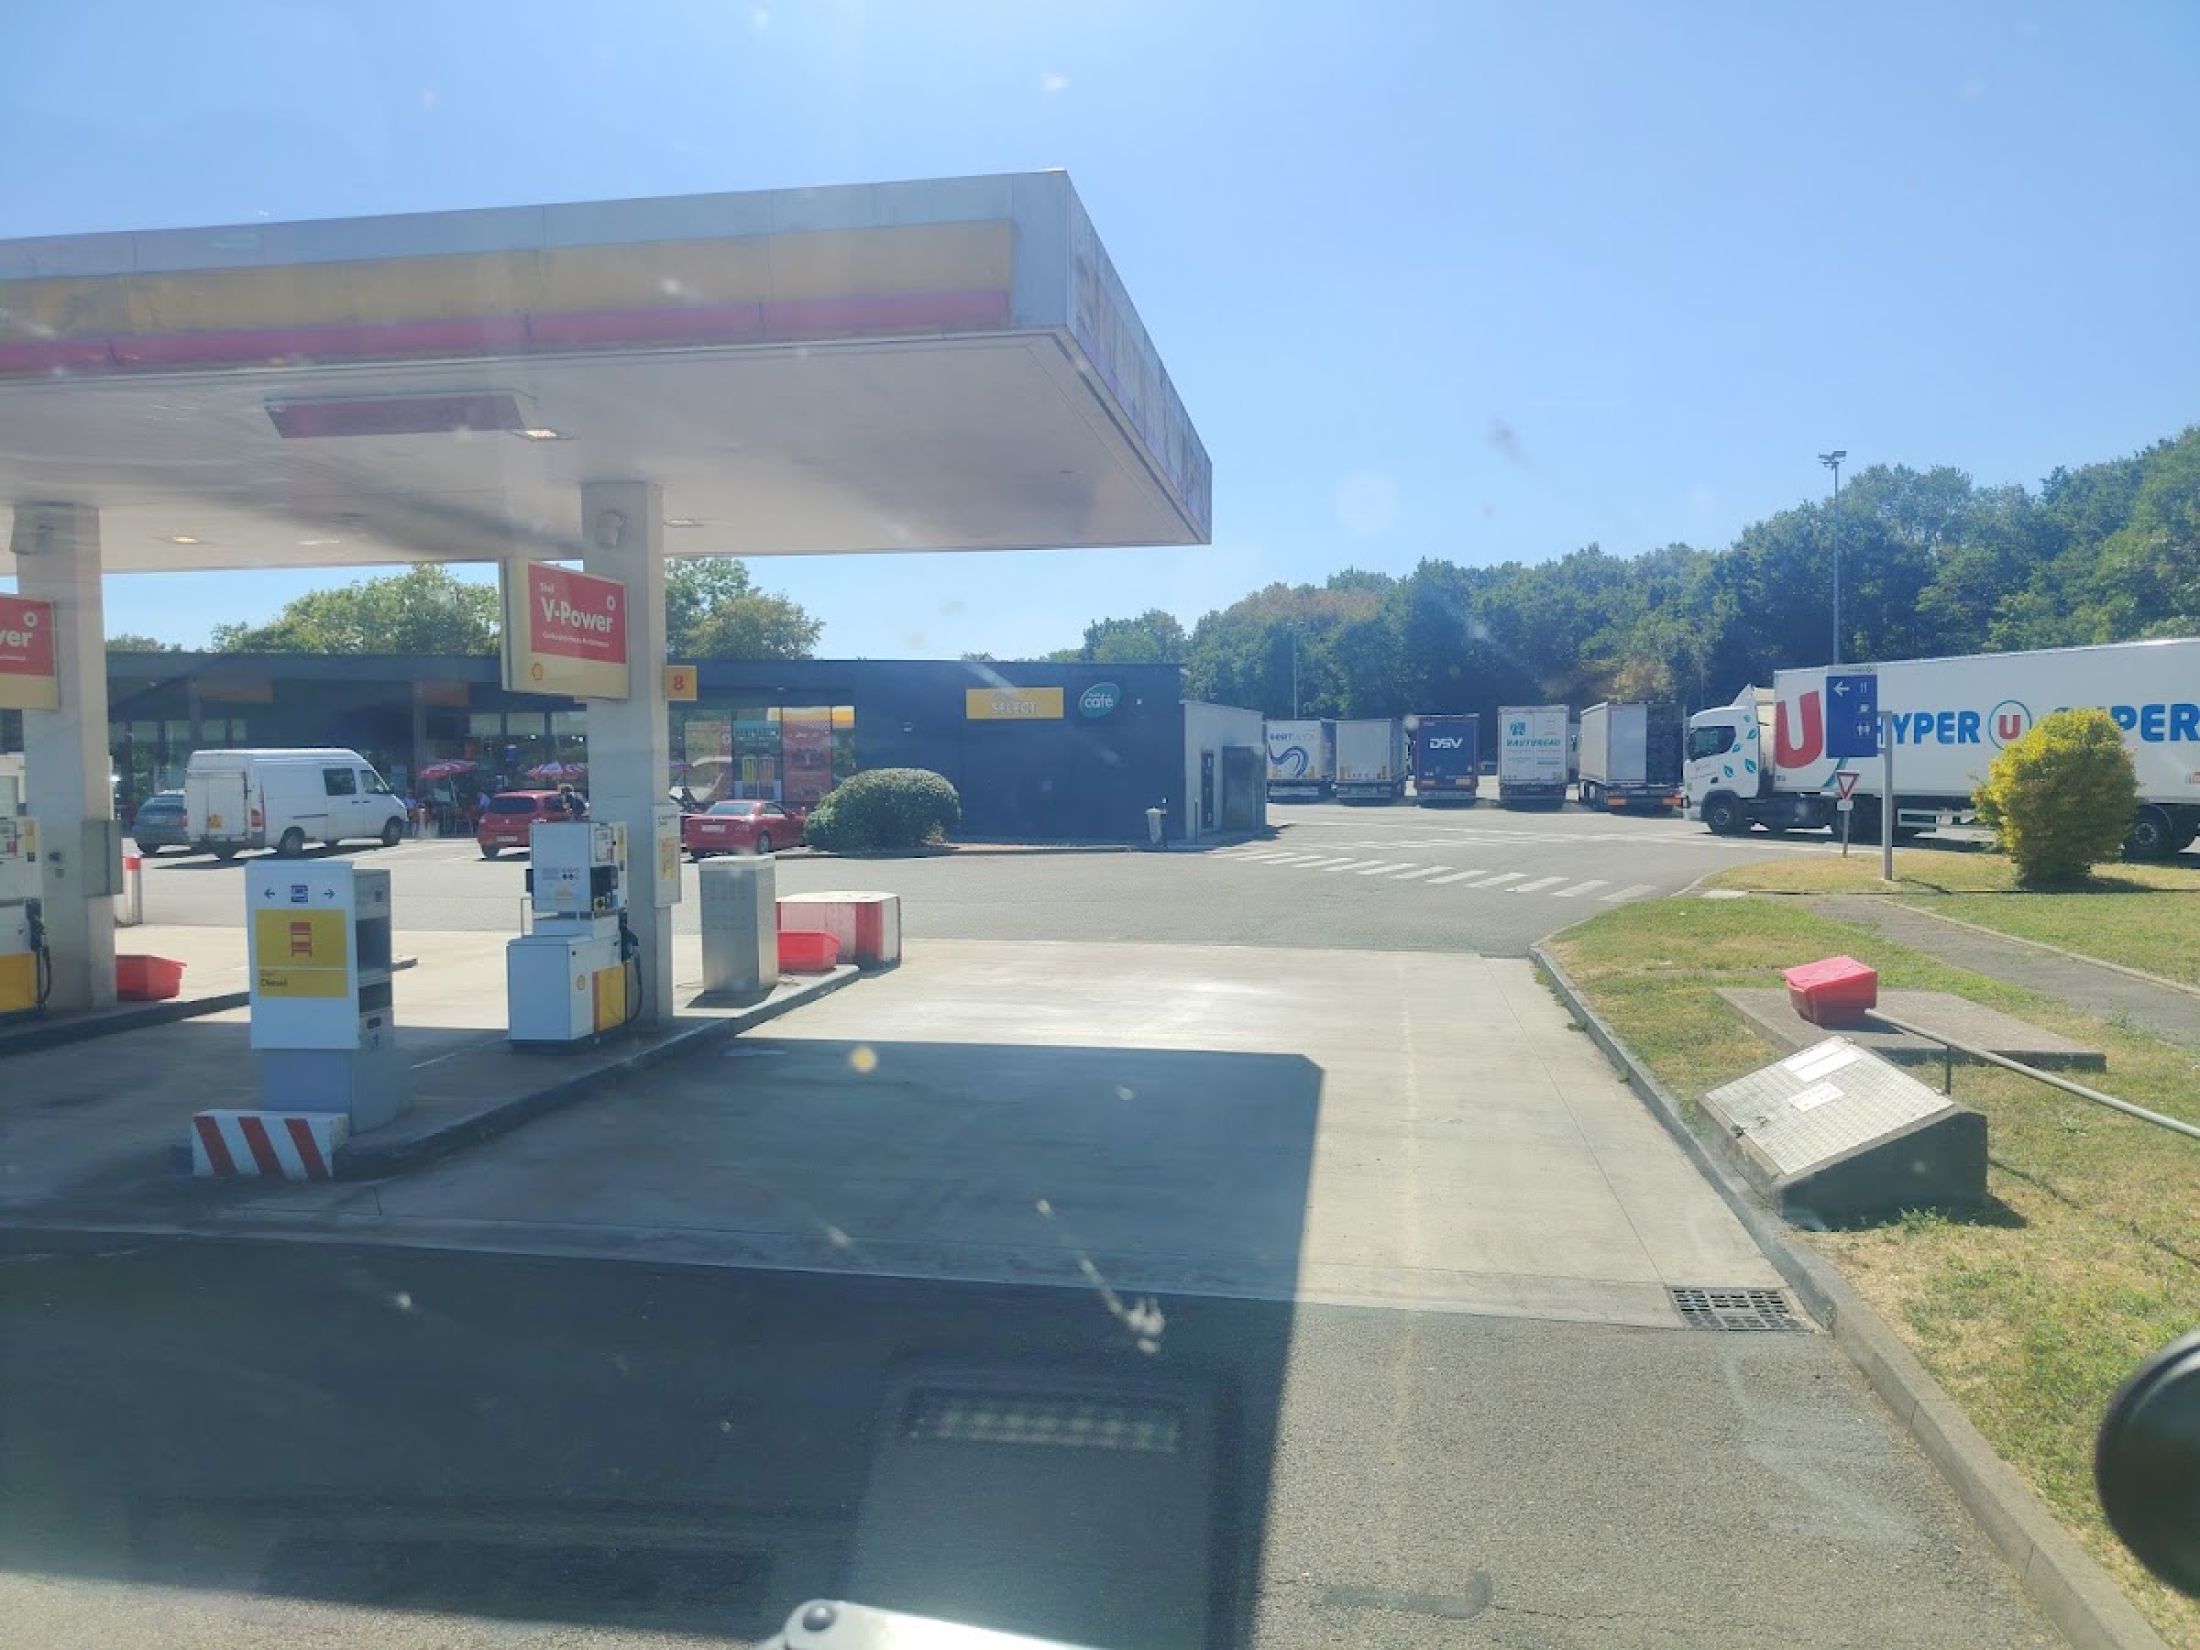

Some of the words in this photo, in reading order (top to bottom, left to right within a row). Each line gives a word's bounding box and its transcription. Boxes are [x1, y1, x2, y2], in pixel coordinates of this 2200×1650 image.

[541, 596, 614, 633] V-Power
[673, 675, 685, 691] 8
[991, 701, 1038, 715] SELECT
[1775, 690, 1823, 769] U
[1998, 714, 2021, 740] U
[1429, 738, 1464, 749] DSV
